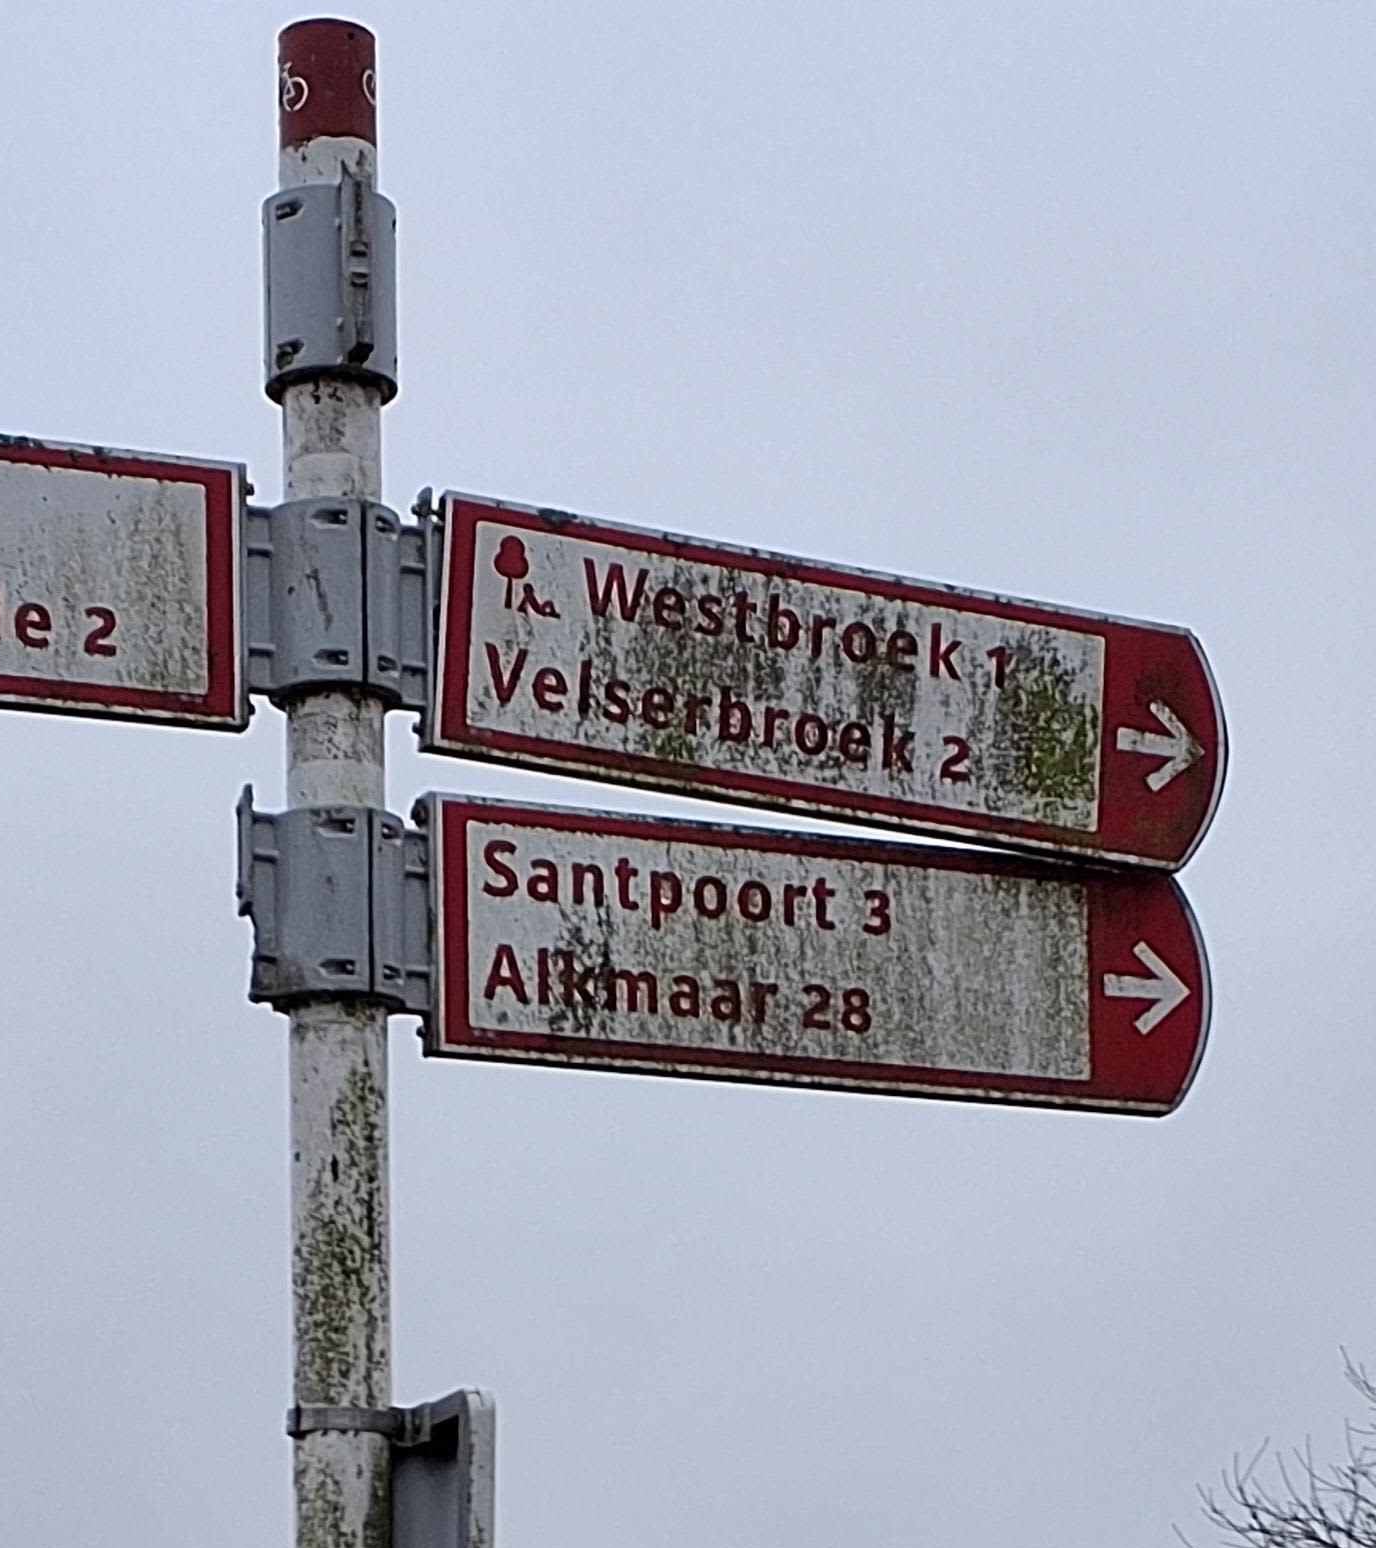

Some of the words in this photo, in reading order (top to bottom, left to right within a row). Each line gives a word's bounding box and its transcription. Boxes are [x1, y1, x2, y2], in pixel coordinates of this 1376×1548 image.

[82, 606, 118, 657] 2
[583, 557, 962, 681] Westbroek
[985, 645, 1017, 689] 1
[483, 642, 914, 772] Velserbroek
[939, 737, 972, 782] 2
[481, 839, 836, 931] Santpoort
[861, 889, 892, 935] 3
[483, 943, 778, 1024] Alkmaar
[799, 983, 873, 1034] 28
